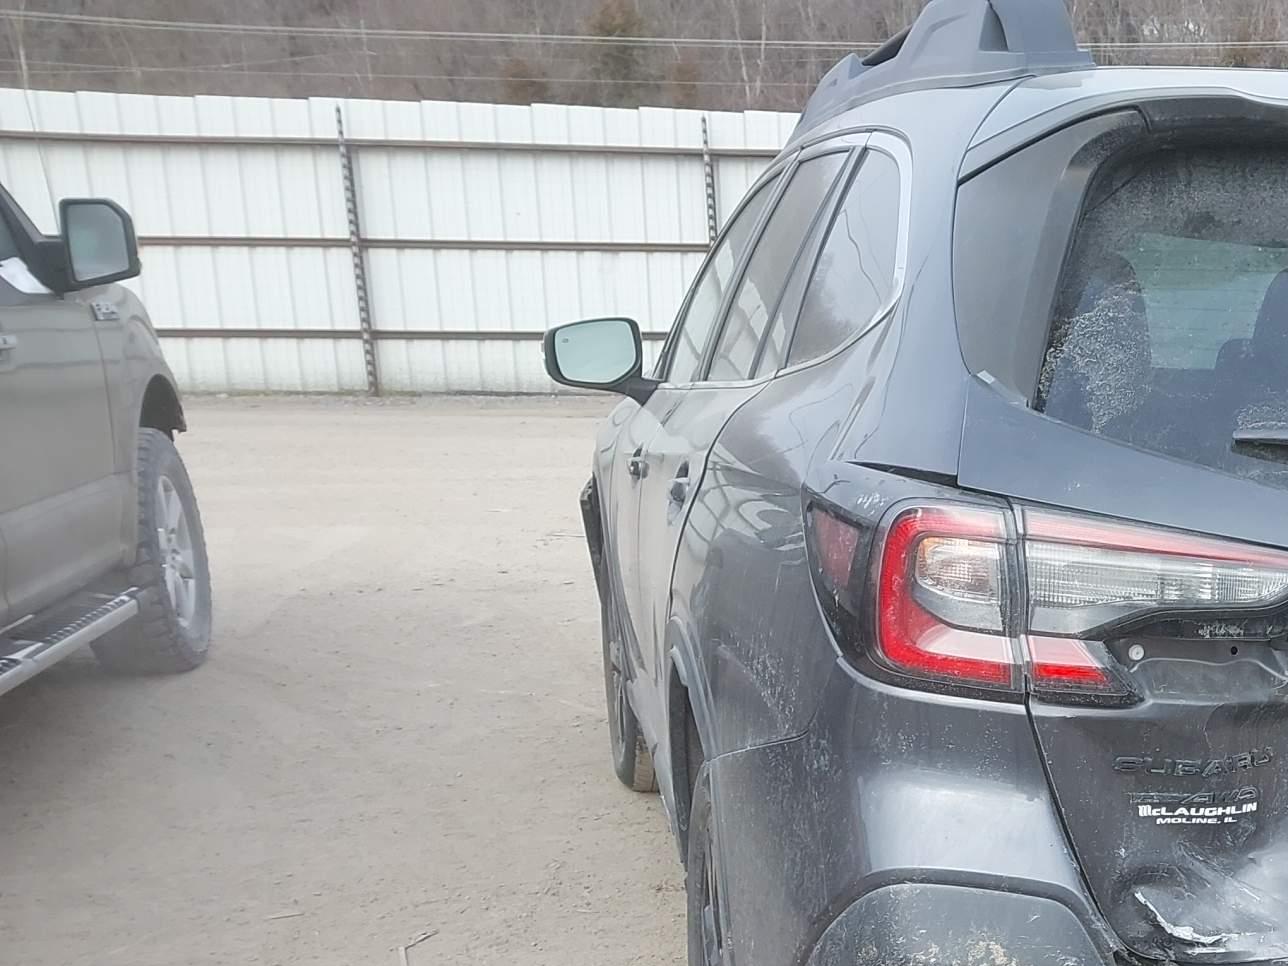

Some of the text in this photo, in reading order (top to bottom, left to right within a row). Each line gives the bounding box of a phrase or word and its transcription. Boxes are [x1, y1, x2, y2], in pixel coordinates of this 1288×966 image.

[1114, 746, 1274, 777] SUBARU
[1137, 802, 1258, 818] McLAUGHLIN
[1155, 816, 1239, 826] MOLINE, IL
